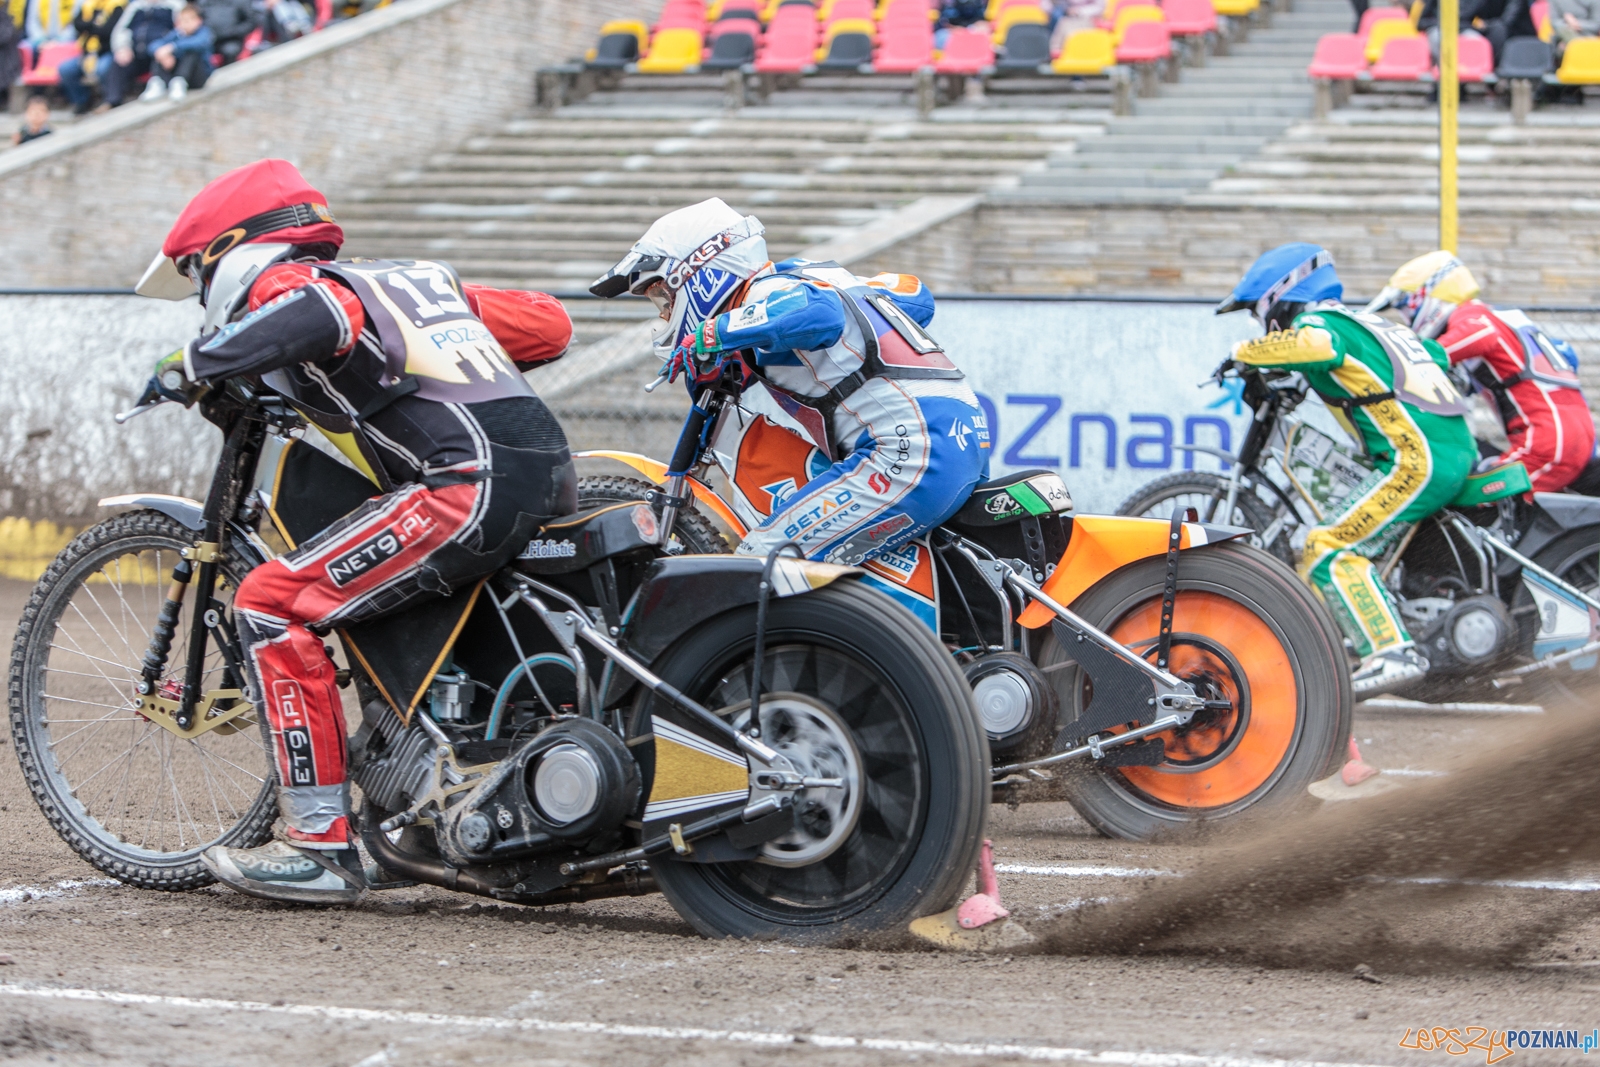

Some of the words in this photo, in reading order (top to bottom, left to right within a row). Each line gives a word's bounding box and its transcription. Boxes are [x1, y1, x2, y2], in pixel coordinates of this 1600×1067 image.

[667, 234, 724, 289] OAKLEY
[387, 269, 469, 319] 13
[331, 513, 432, 580] NET9.PL
[529, 539, 577, 558] Holistic
[798, 502, 861, 546] EASING
[281, 686, 311, 783] ET9.PL
